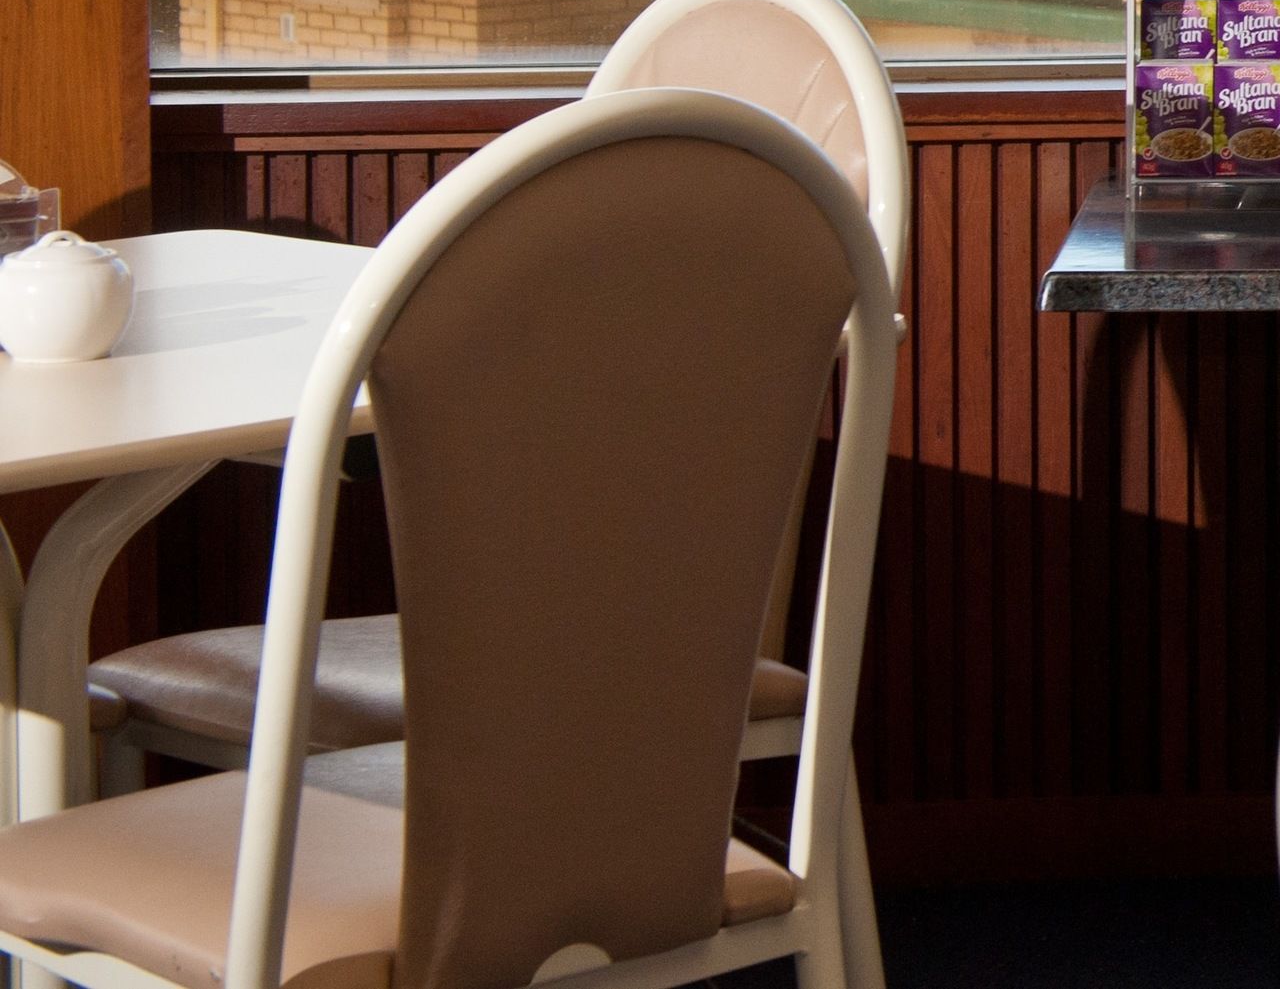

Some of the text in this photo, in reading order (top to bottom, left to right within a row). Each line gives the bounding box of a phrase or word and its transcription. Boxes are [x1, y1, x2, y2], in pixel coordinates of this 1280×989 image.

[1146, 16, 1208, 42] Sultana
[1240, 29, 1278, 48] Bran
[1162, 30, 1202, 49] Bran
[1141, 82, 1205, 110] Sultana
[1236, 96, 1276, 115] Bran
[1159, 97, 1198, 116] Bran
